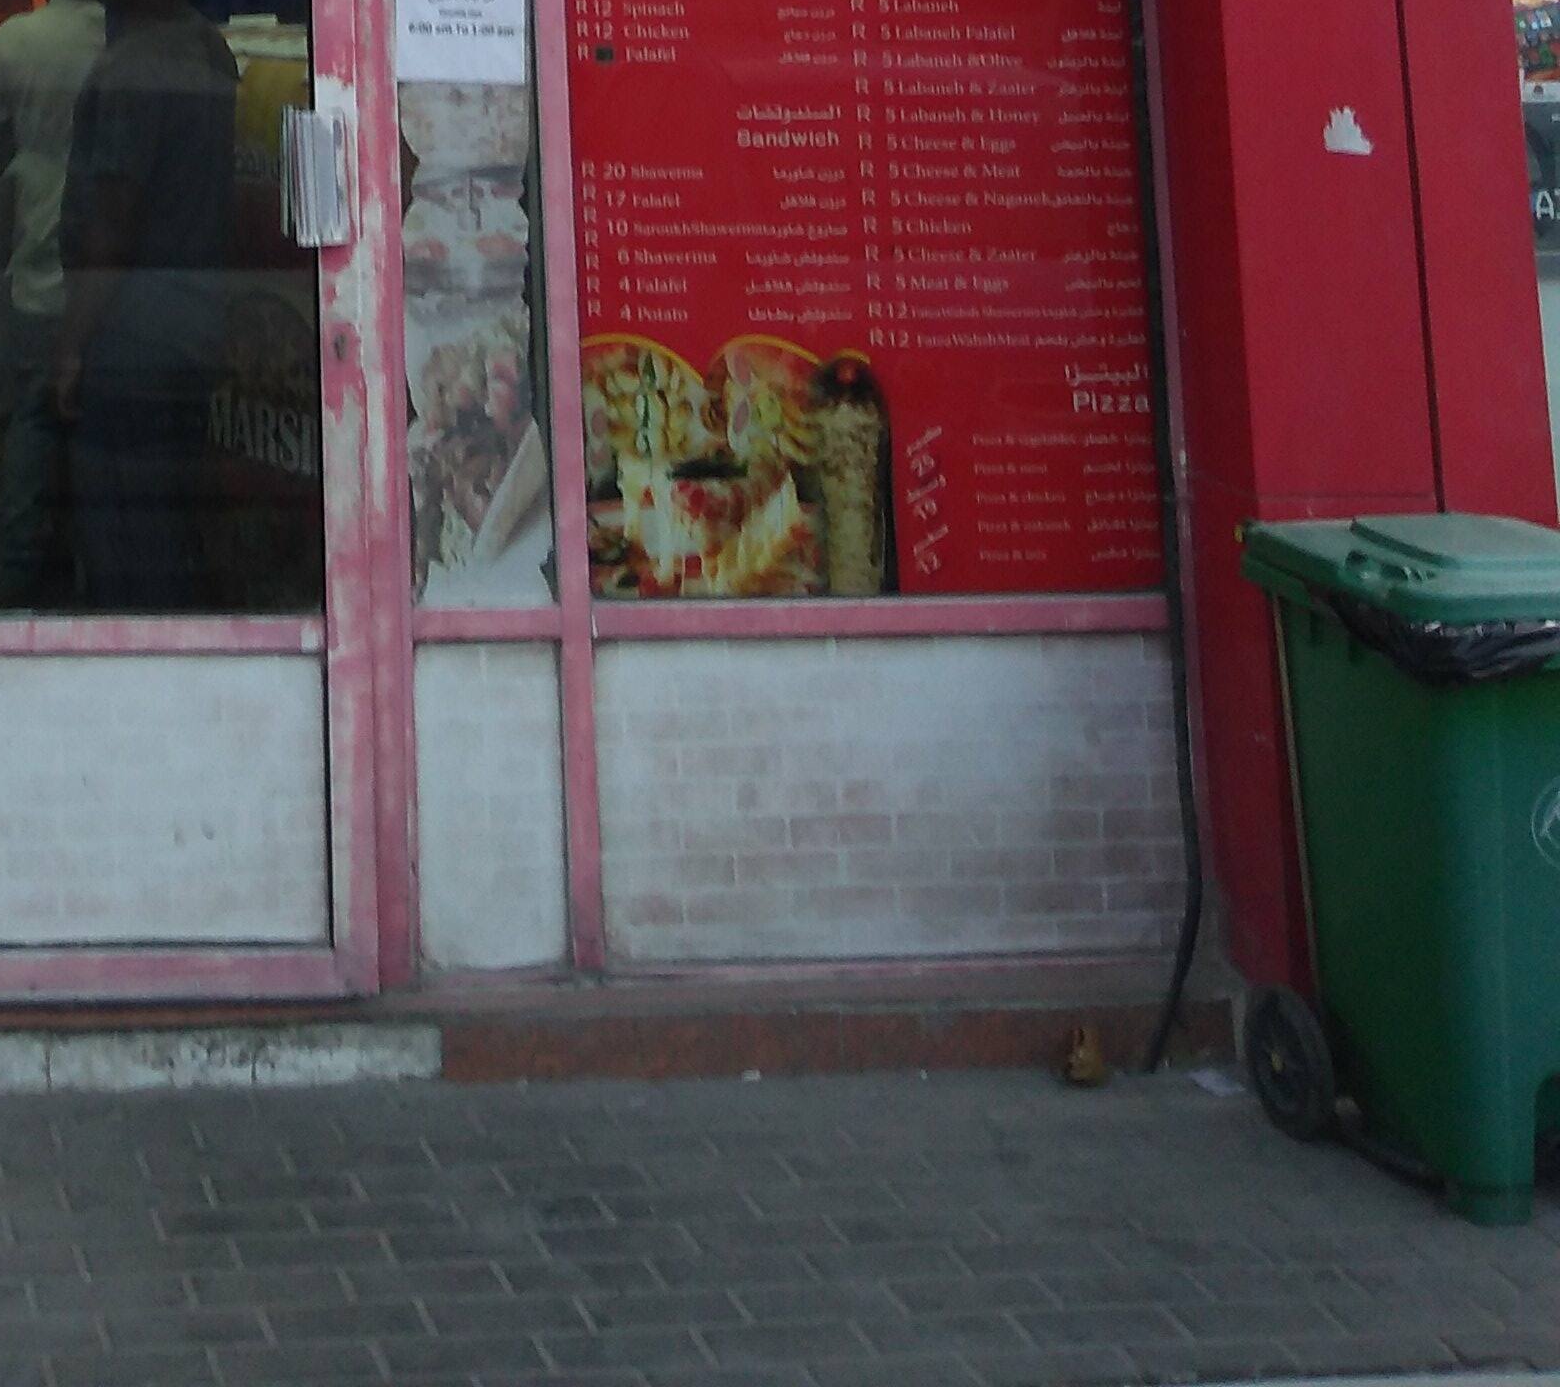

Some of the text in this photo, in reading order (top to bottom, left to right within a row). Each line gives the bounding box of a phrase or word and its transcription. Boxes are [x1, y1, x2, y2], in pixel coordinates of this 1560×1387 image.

[736, 130, 840, 149] Sandwich
[1072, 390, 1152, 415] Pizza
[207, 390, 320, 477] MARSI
